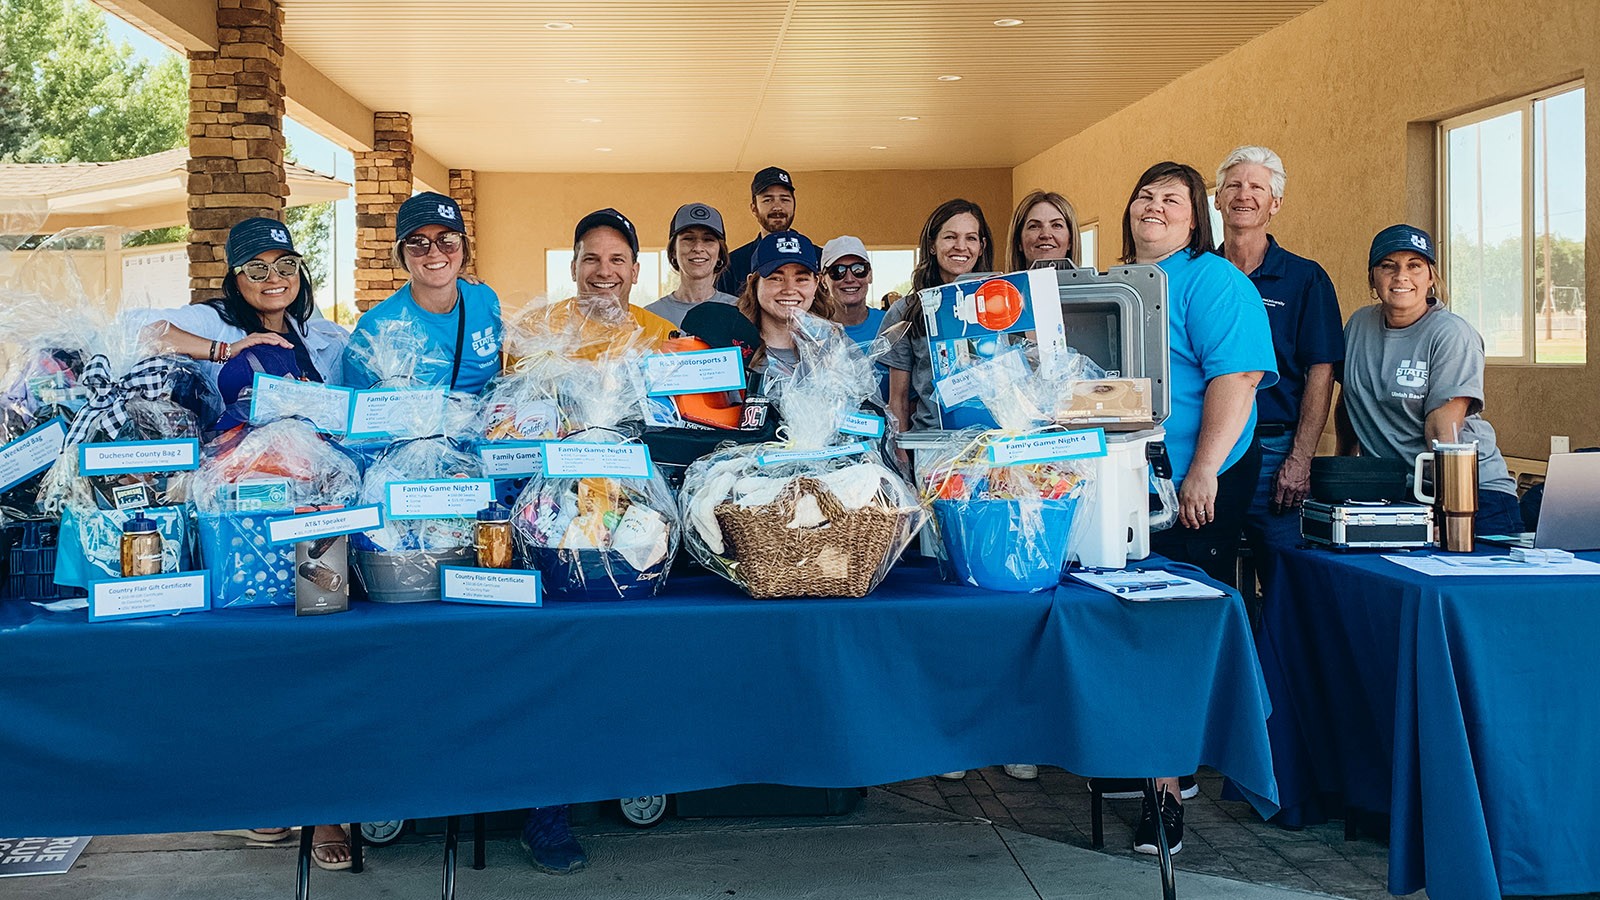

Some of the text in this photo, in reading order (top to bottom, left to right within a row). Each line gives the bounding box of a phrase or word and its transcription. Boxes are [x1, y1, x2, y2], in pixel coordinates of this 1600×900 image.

[472, 333, 495, 351] STATE
[677, 357, 721, 366] Motorsports
[1396, 368, 1428, 380] STATE
[741, 406, 768, 427] SC1
[1058, 436, 1079, 445] Night
[99, 451, 133, 459] Duchesne
[135, 450, 160, 458] County
[402, 485, 427, 493] Family
[453, 484, 473, 492] Night
[304, 517, 346, 528] AT&T Speaker
[108, 587, 133, 595] Country
[161, 582, 192, 590] Certificate
[1, 837, 47, 864] LUE
